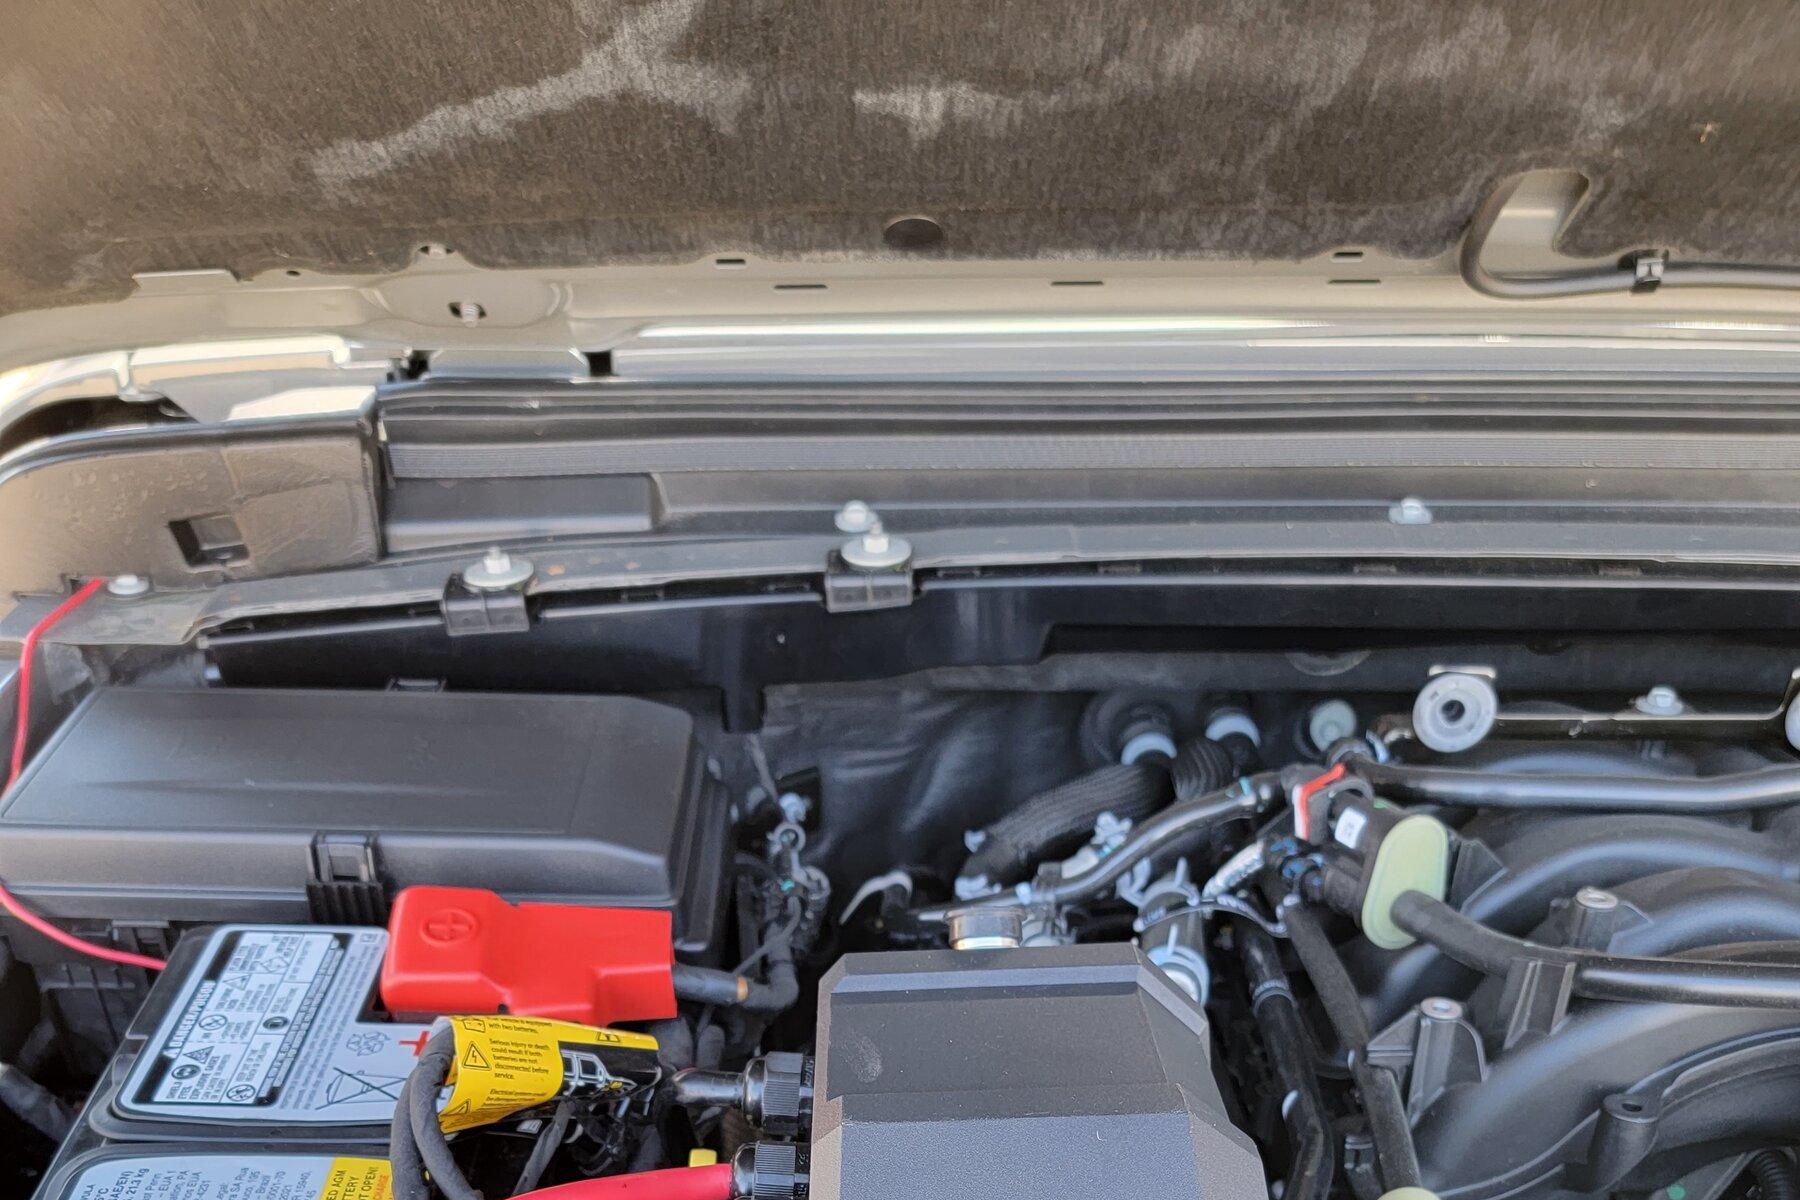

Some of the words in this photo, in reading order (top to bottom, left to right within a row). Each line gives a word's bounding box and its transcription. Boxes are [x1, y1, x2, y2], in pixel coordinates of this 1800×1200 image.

[489, 1038, 510, 1046] Serious
[493, 1054, 518, 1062] batteries
[495, 1063, 530, 1072] disconnected
[126, 1180, 142, 1194] 21.3
[134, 1168, 149, 1177] kg
[177, 1171, 188, 1180] PA
[187, 1172, 202, 1187] EUA
[332, 1170, 346, 1187] AGM
[361, 1167, 377, 1191] OPEN!
[158, 1176, 172, 1191] EUA
[230, 1182, 242, 1192] SA
